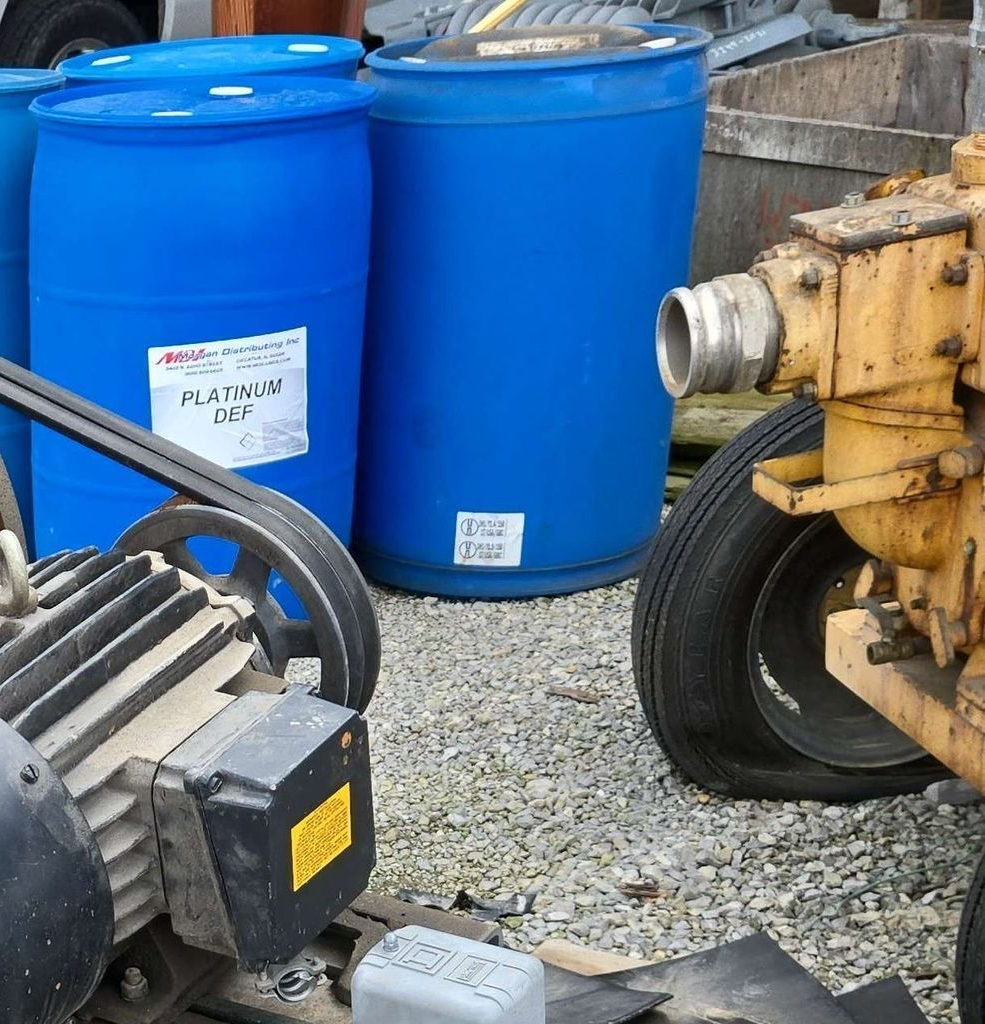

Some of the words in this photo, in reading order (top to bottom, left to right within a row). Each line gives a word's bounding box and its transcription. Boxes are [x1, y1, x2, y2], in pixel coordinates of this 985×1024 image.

[221, 340, 283, 357] Distributing
[285, 336, 301, 346] Inc
[181, 378, 282, 407] PLATINUM
[214, 404, 253, 424] DEF
